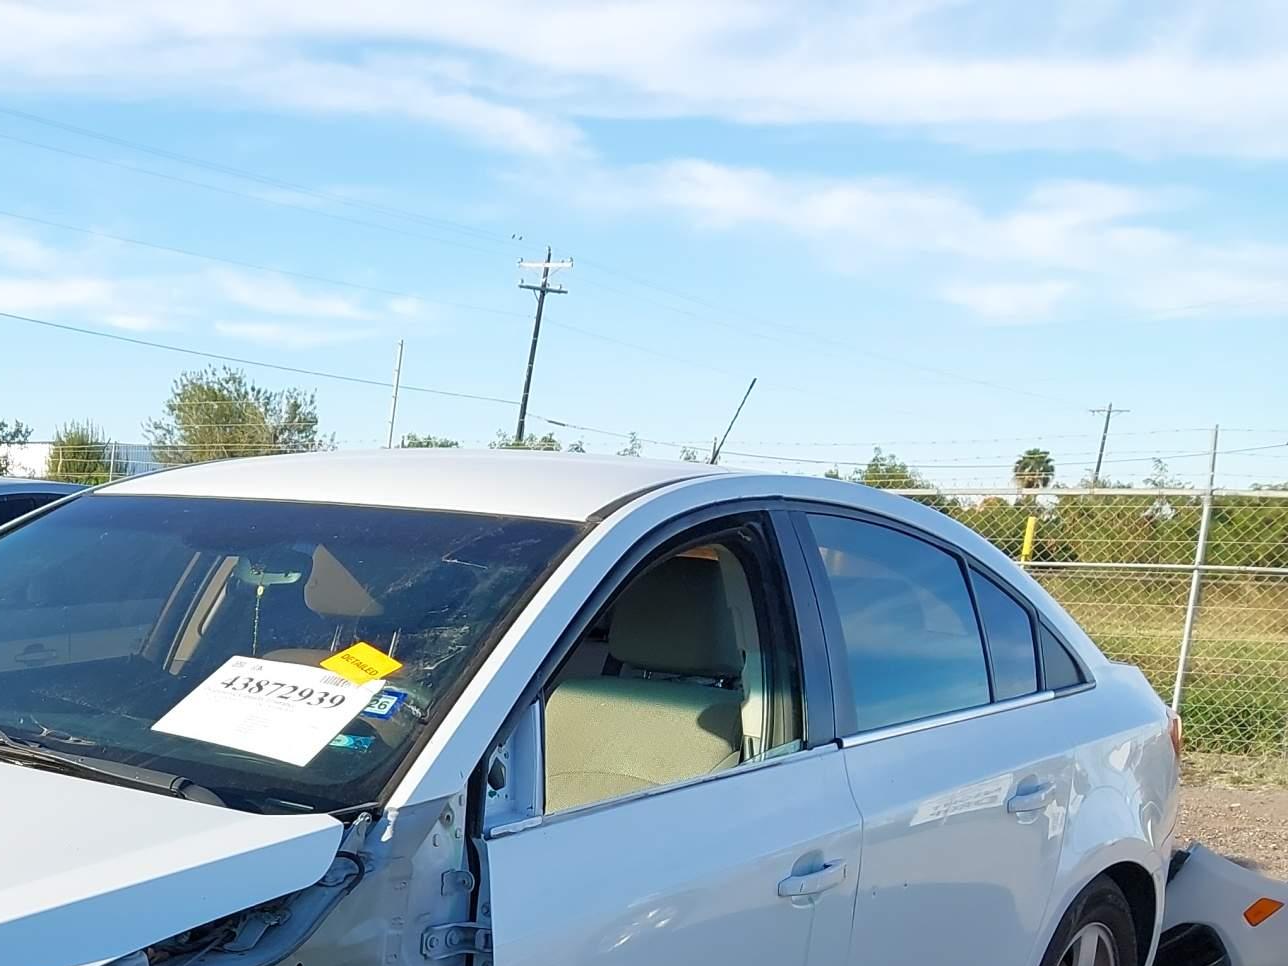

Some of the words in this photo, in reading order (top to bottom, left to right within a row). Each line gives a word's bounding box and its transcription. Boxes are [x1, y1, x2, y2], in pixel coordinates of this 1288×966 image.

[341, 653, 379, 677] DETAILED
[220, 675, 346, 709] 43872939
[368, 698, 389, 711] 26
